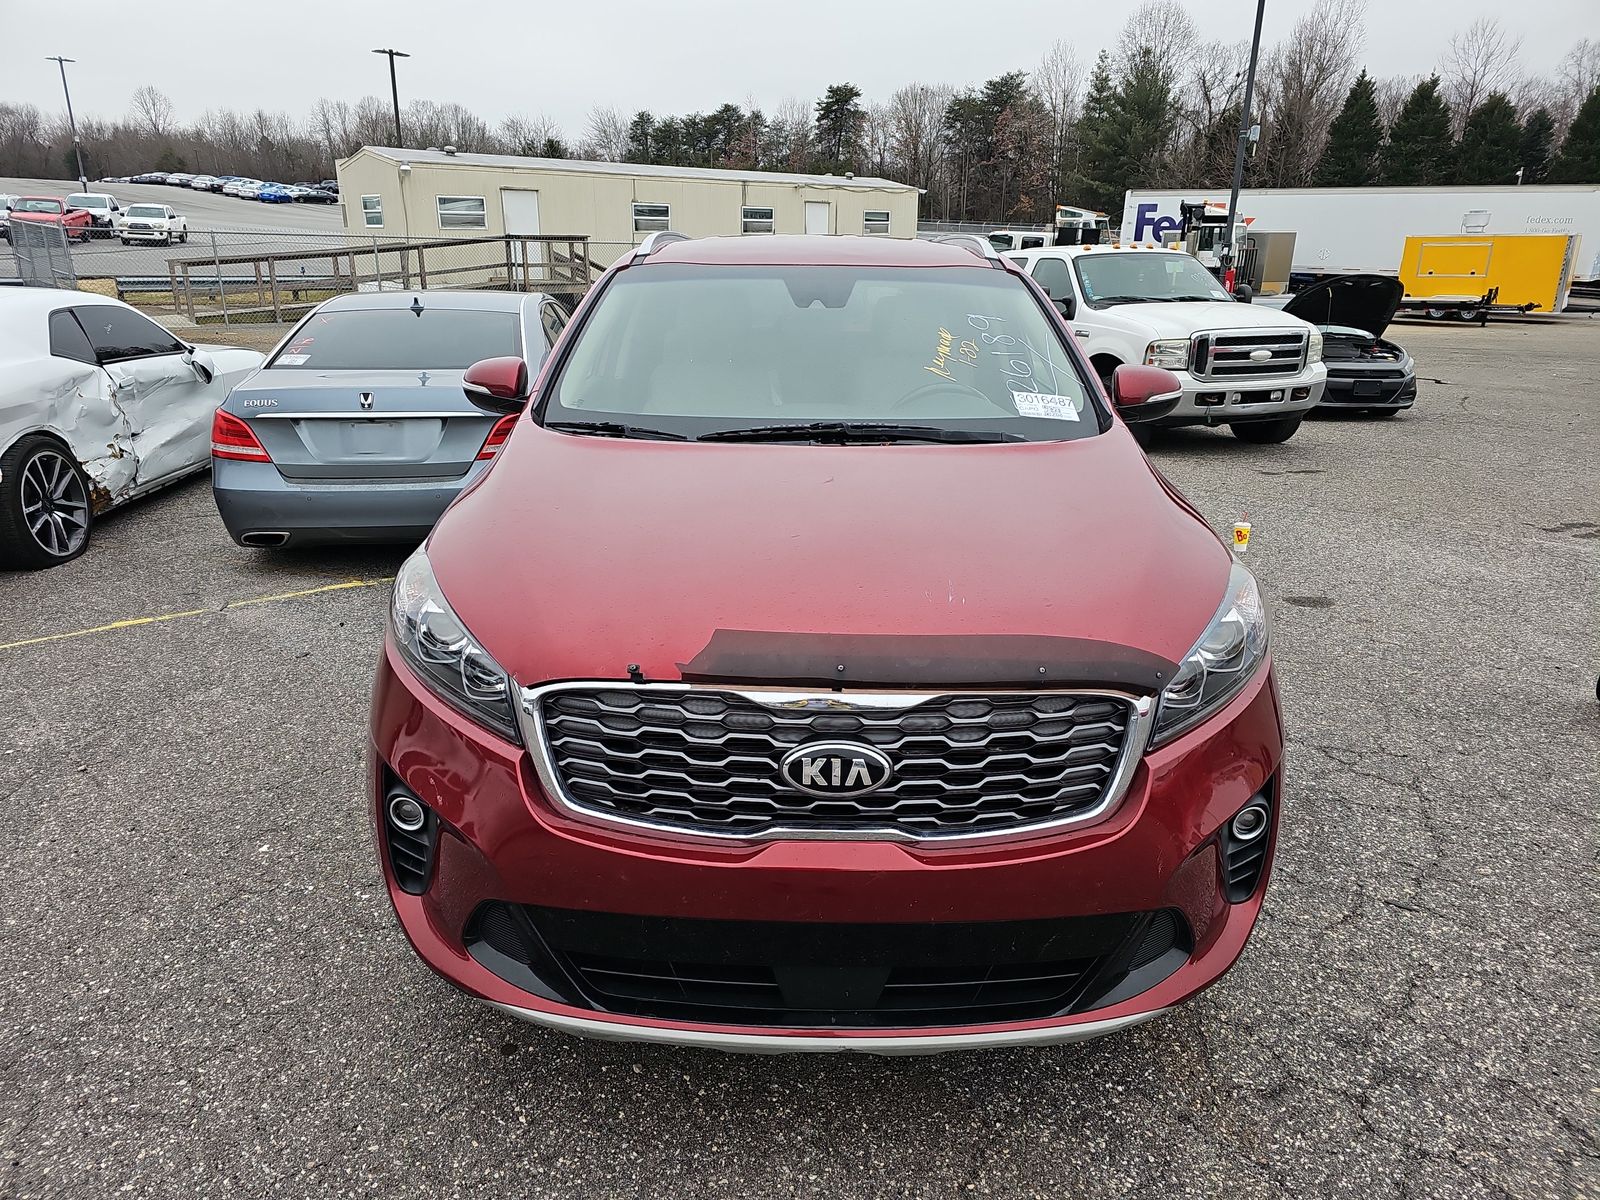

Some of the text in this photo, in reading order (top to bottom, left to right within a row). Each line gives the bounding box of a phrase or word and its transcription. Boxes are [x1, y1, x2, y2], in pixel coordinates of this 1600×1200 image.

[1526, 215, 1574, 224] fedex.com
[244, 399, 278, 407] EQUUS
[1017, 393, 1074, 408] 3016487
[801, 757, 873, 787] KIA
